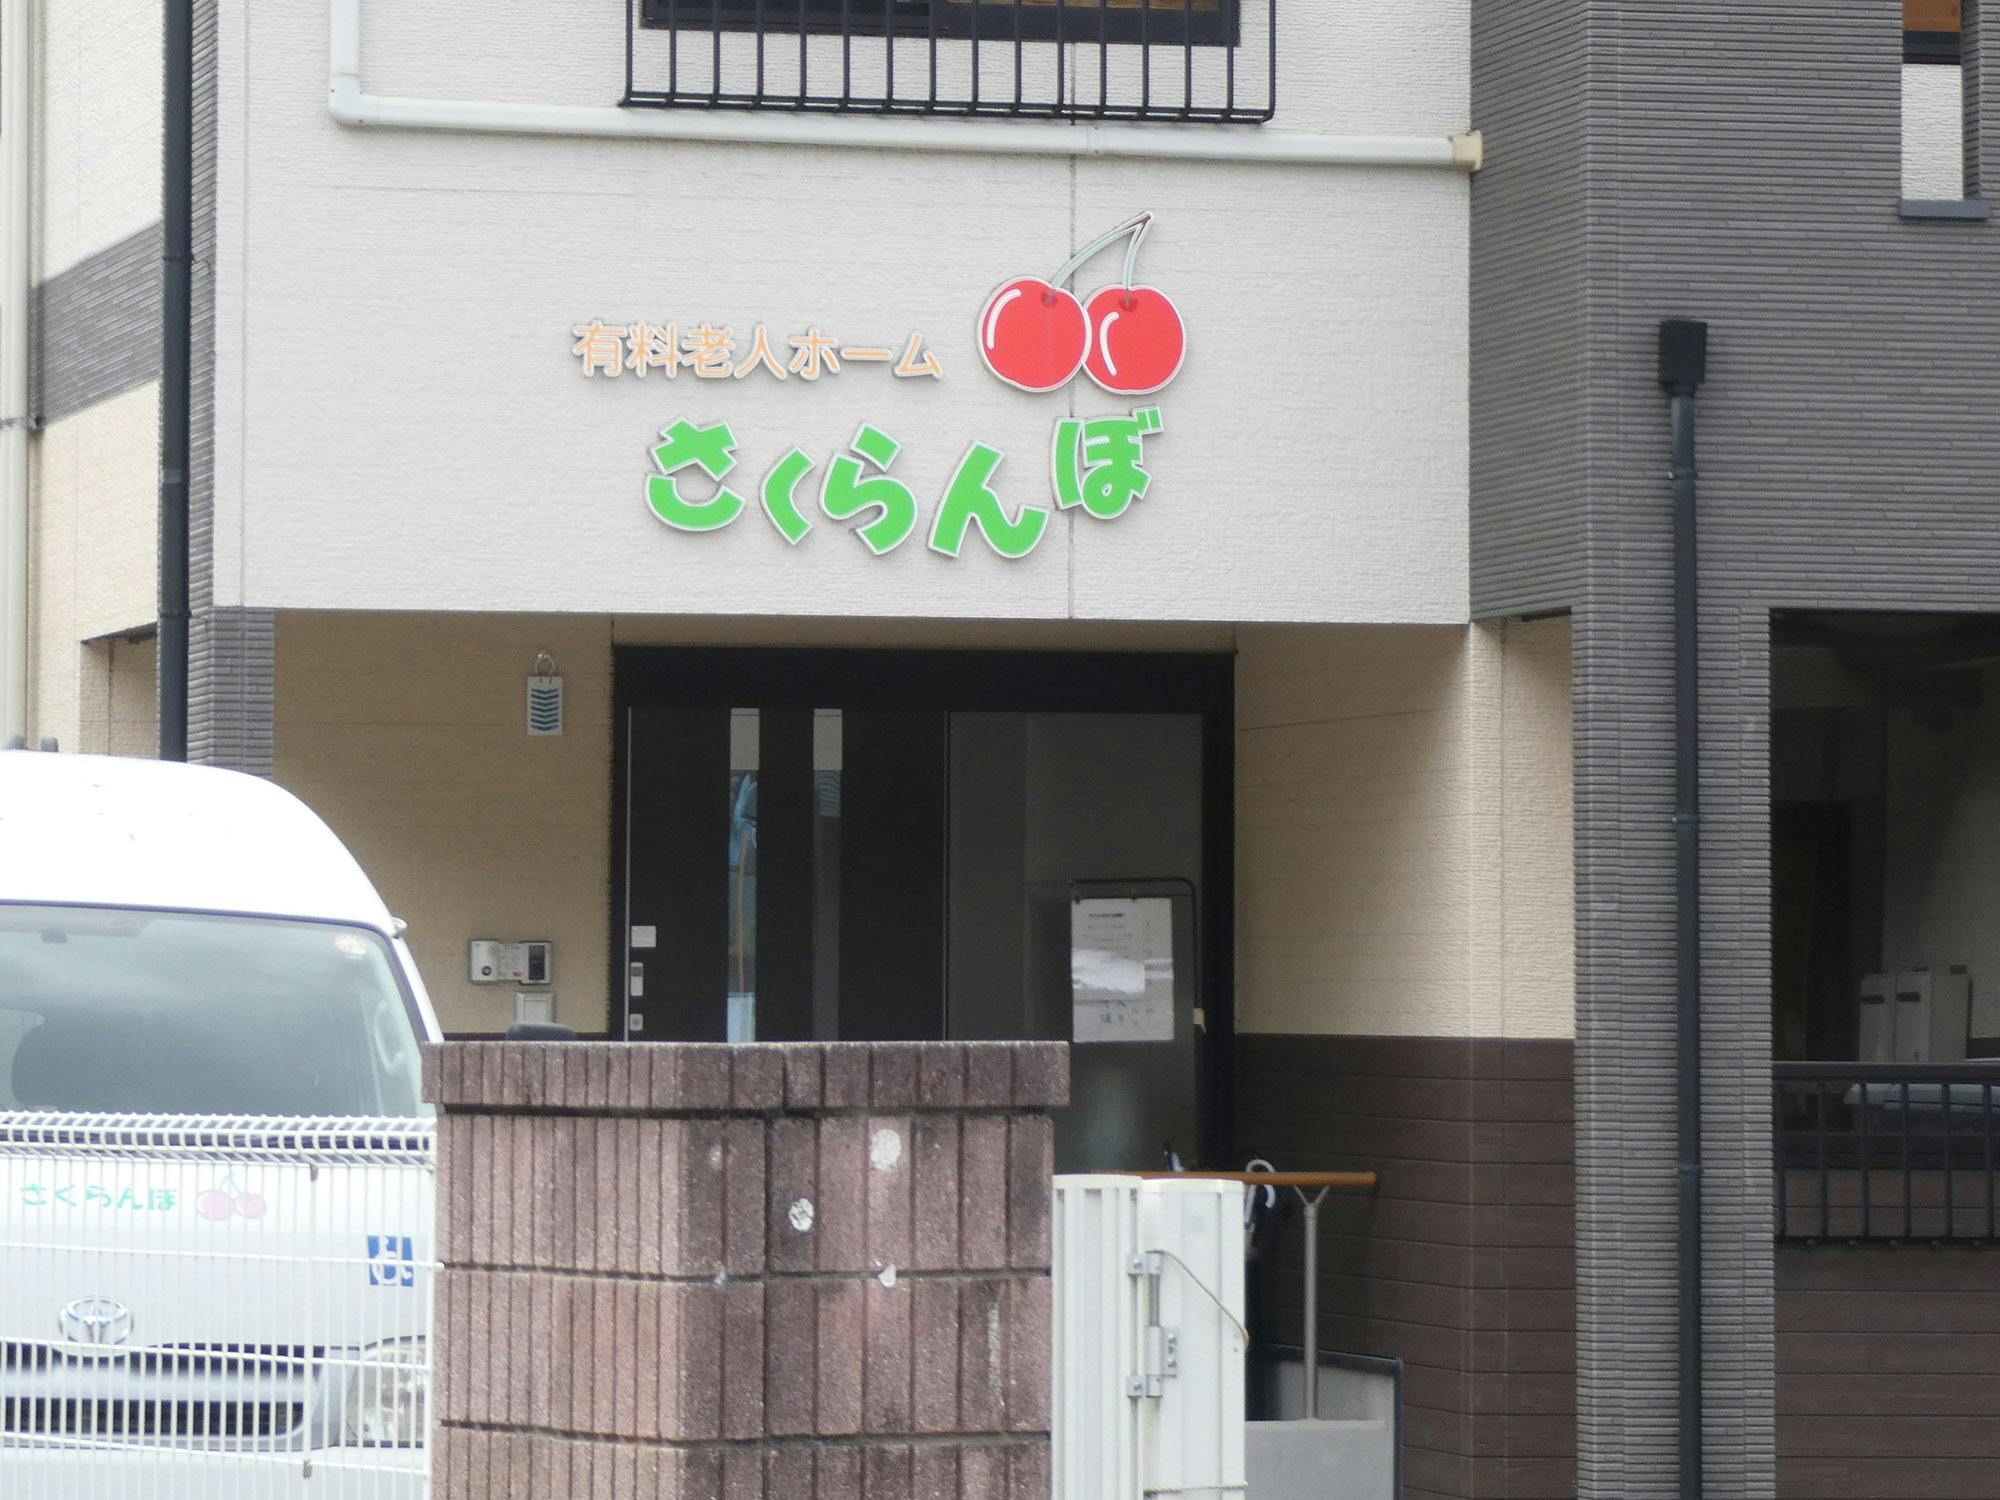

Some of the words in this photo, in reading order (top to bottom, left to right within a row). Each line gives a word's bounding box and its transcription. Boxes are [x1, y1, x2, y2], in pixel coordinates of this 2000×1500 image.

[573, 320, 943, 379] 有料老人ホーム
[646, 407, 1164, 558] さくらんぼ
